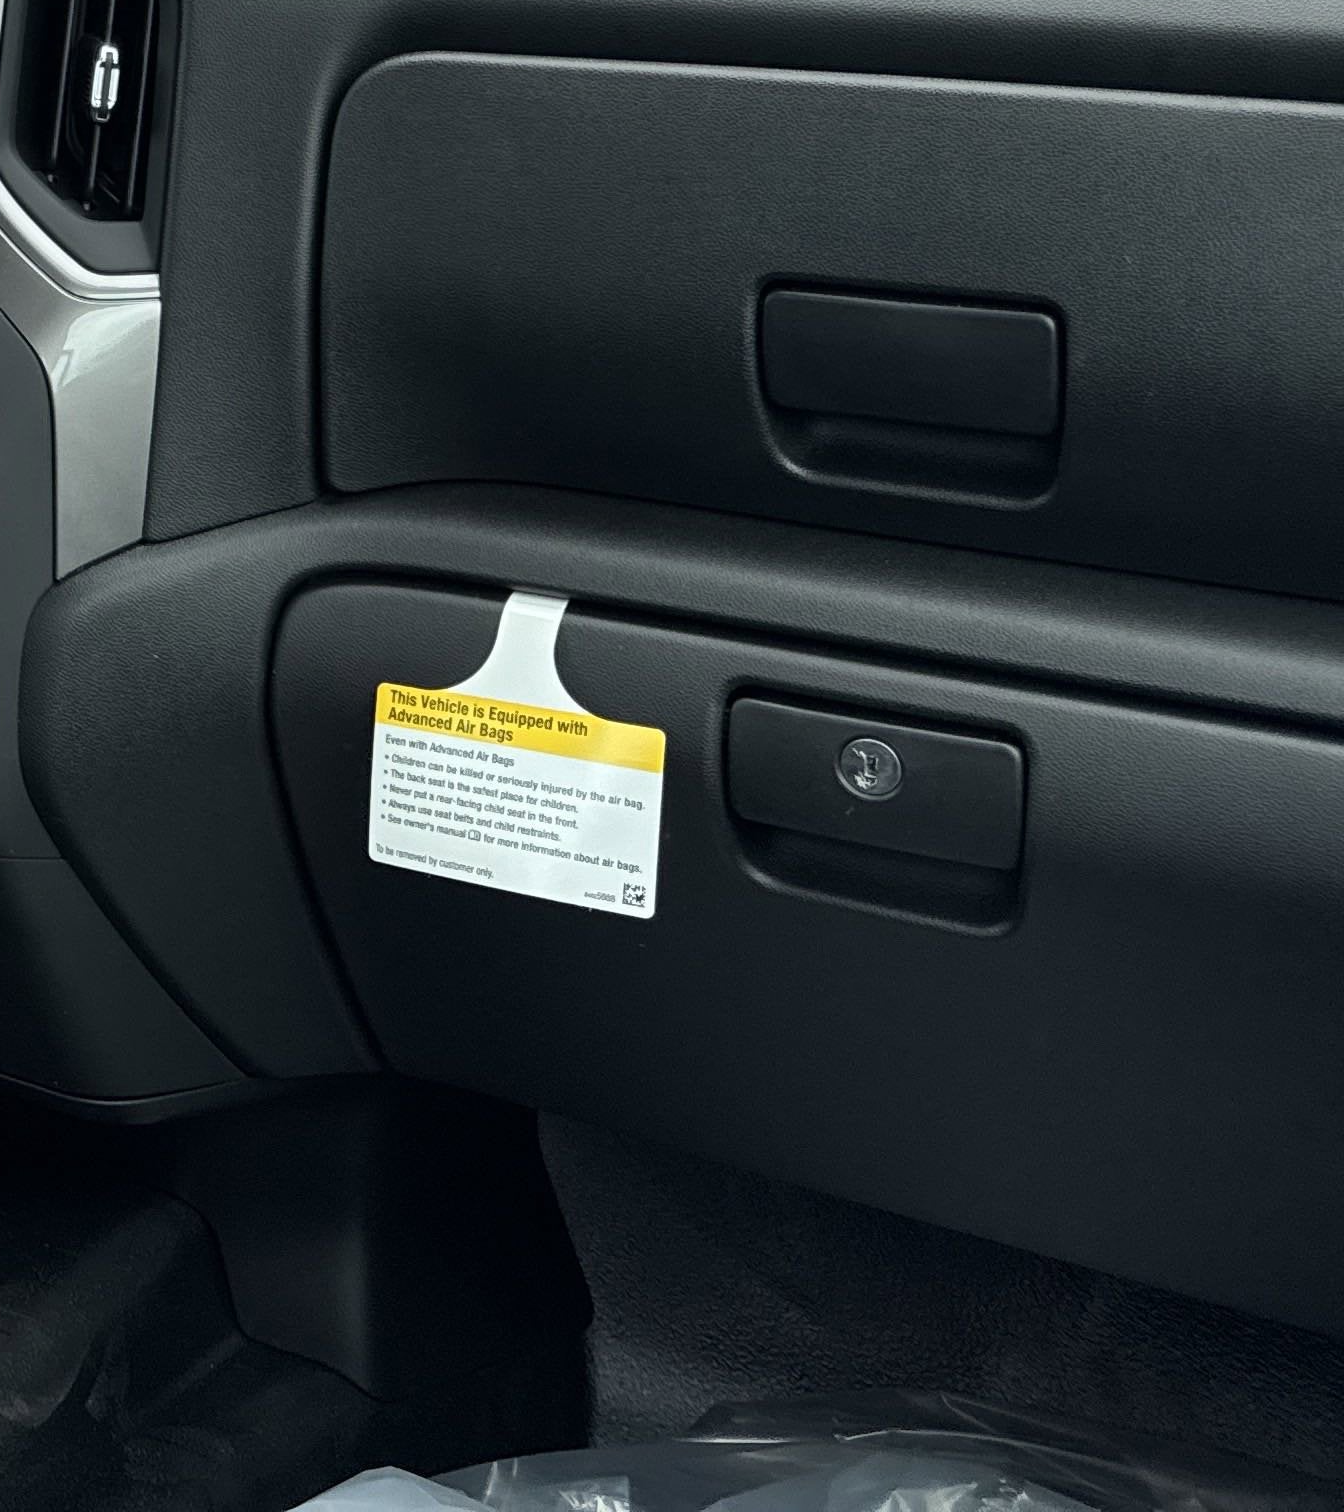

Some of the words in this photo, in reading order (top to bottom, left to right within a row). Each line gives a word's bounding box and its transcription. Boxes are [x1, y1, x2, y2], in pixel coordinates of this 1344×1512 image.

[388, 706, 452, 730] Advanced
[456, 719, 476, 734] Air
[480, 722, 514, 743] Bags
[390, 689, 417, 707] This
[421, 695, 469, 716] Vehicle
[473, 704, 484, 718] is
[489, 706, 554, 730] Equipped
[557, 720, 588, 737] with
[385, 734, 406, 747] Even
[409, 739, 427, 750] with
[430, 742, 474, 759] Advanced
[476, 751, 489, 762] Air
[492, 753, 515, 768] Bags
[391, 769, 404, 780] The
[407, 772, 426, 784] back
[428, 777, 445, 788] seat
[448, 781, 454, 790] is
[457, 782, 470, 792] the
[473, 786, 498, 798] safest
[500, 791, 524, 803] place
[526, 795, 538, 805] for
[540, 799, 579, 814] children.
[392, 754, 426, 768] Children
[428, 763, 443, 772] can
[446, 764, 457, 774] be
[459, 767, 484, 779] killed
[486, 773, 495, 781] or
[497, 775, 538, 791] seriously
[541, 782, 573, 797] injured
[576, 788, 588, 801] by
[590, 792, 605, 804] the
[608, 794, 621, 805] air
[624, 797, 646, 811] bag.
[388, 799, 416, 813] Always
[418, 807, 432, 816] use
[434, 810, 452, 820] seat
[454, 812, 474, 824] belts
[476, 818, 492, 828] and
[494, 821, 515, 833] child
[517, 826, 561, 842] restraints.
[390, 784, 412, 796] Never
[414, 790, 427, 800] put
[436, 794, 482, 812] rear-facing
[484, 804, 505, 815] child
[507, 808, 526, 819] seat
[528, 811, 536, 820] in
[539, 813, 552, 825] the
[555, 816, 579, 829] front.
[376, 843, 384, 853] To
[386, 846, 393, 856] be
[396, 850, 426, 863] removed
[429, 855, 437, 867] by
[439, 859, 474, 873] customer
[476, 867, 494, 879] only.
[388, 814, 401, 824] See
[404, 818, 434, 832] owner's
[436, 826, 466, 838] manual
[484, 834, 495, 844] for
[497, 838, 519, 849] more
[521, 841, 571, 859] information
[574, 853, 599, 865] about
[602, 858, 614, 867] air
[617, 860, 642, 873] bags.
